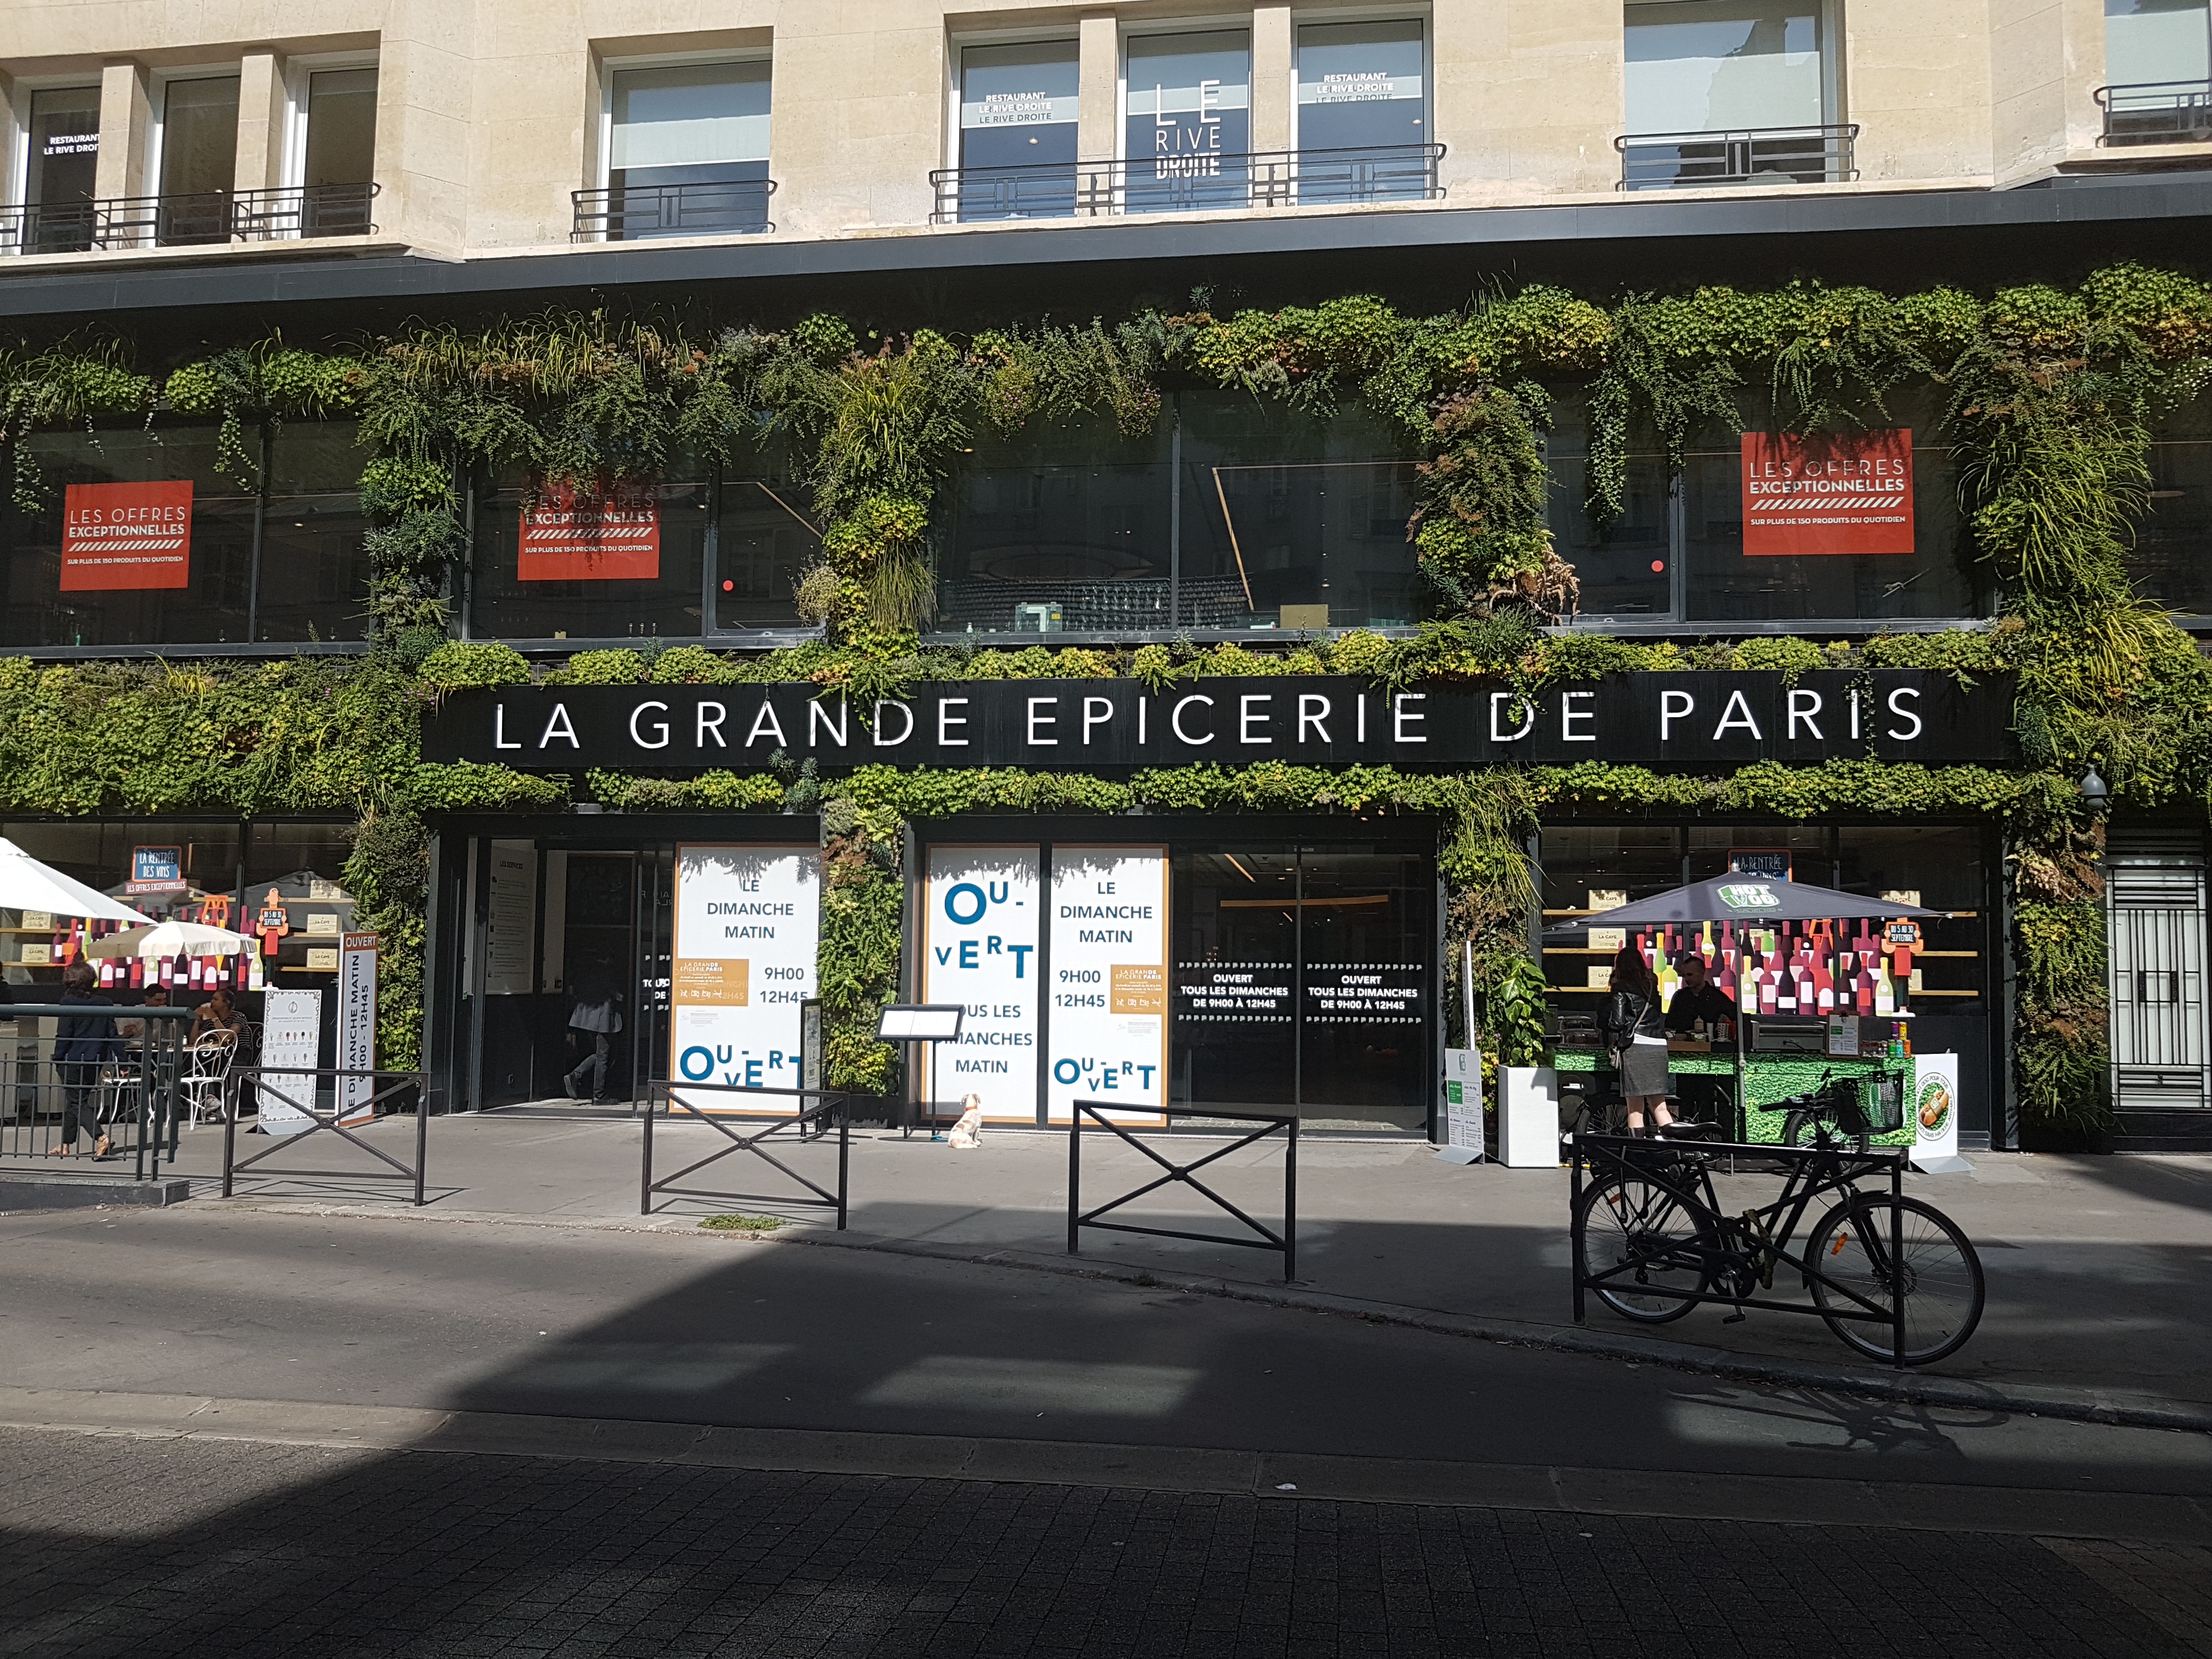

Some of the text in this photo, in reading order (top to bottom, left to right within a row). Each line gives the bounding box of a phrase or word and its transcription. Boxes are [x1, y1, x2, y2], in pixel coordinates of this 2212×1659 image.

[1324, 72, 1387, 83] RESTAURANT
[1317, 83, 1393, 94] LE RIVE DROITE
[986, 92, 1046, 103] RESTAURANT
[1156, 80, 1221, 126] LE
[979, 102, 1052, 114] LE RIVE DROITE
[1156, 127, 1220, 152] RIVE
[56, 145, 74, 154] RIVE
[1156, 152, 1221, 180] DROITE
[1750, 459, 1904, 478] LES OFFRES
[1750, 479, 1905, 494] EXCEPTIONNELLES
[573, 493, 654, 509] OFFRES
[70, 506, 185, 524] LES OFFRES
[526, 511, 654, 525] EXCEPTIONNELLES
[1863, 516, 1905, 524] QUOTIDIEN
[69, 524, 185, 538] EXCEPTIONNELLES
[493, 687, 1922, 749] LA GRANDE EPICERIE DE PARIS
[140, 850, 174, 864] LA RENTRÉE
[1737, 854, 1782, 870] LA RENTRÉE
[143, 865, 170, 878] DES VINS
[136, 883, 150, 891] OFFRES
[151, 882, 185, 890] EXCEPTIONNELLES
[742, 879, 759, 892] LE
[1098, 882, 1116, 894] LE
[1729, 884, 1771, 895] HOT
[707, 902, 794, 916] DIMANCHE
[1060, 906, 1153, 919] DIMANCHE
[725, 926, 775, 939] MATIN
[1908, 925, 1914, 933] 30
[346, 936, 377, 947] OUVERT
[1079, 930, 1133, 943] MATIN
[1891, 934, 1914, 942] SEPTEMBRE
[351, 955, 359, 1004] MATIN
[764, 967, 804, 980] 9H00
[1059, 970, 1101, 983] 9H00
[1213, 974, 1254, 983] OUVERT
[1341, 975, 1382, 984] OUVERT
[760, 991, 808, 1003] 12H45
[1181, 986, 1288, 996] TOUS LES DIMANCHES
[1308, 988, 1335, 996] TOUS
[1357, 988, 1418, 997] DIMANCHES
[1054, 994, 1105, 1007] 12H45
[1193, 997, 1276, 1008] DE 9H00 À 12H45
[1321, 999, 1405, 1009] DE 9H00 À 12H45
[360, 985, 369, 1031] 12H45
[994, 1005, 1021, 1018] LES
[956, 1059, 1008, 1073] MATIN
